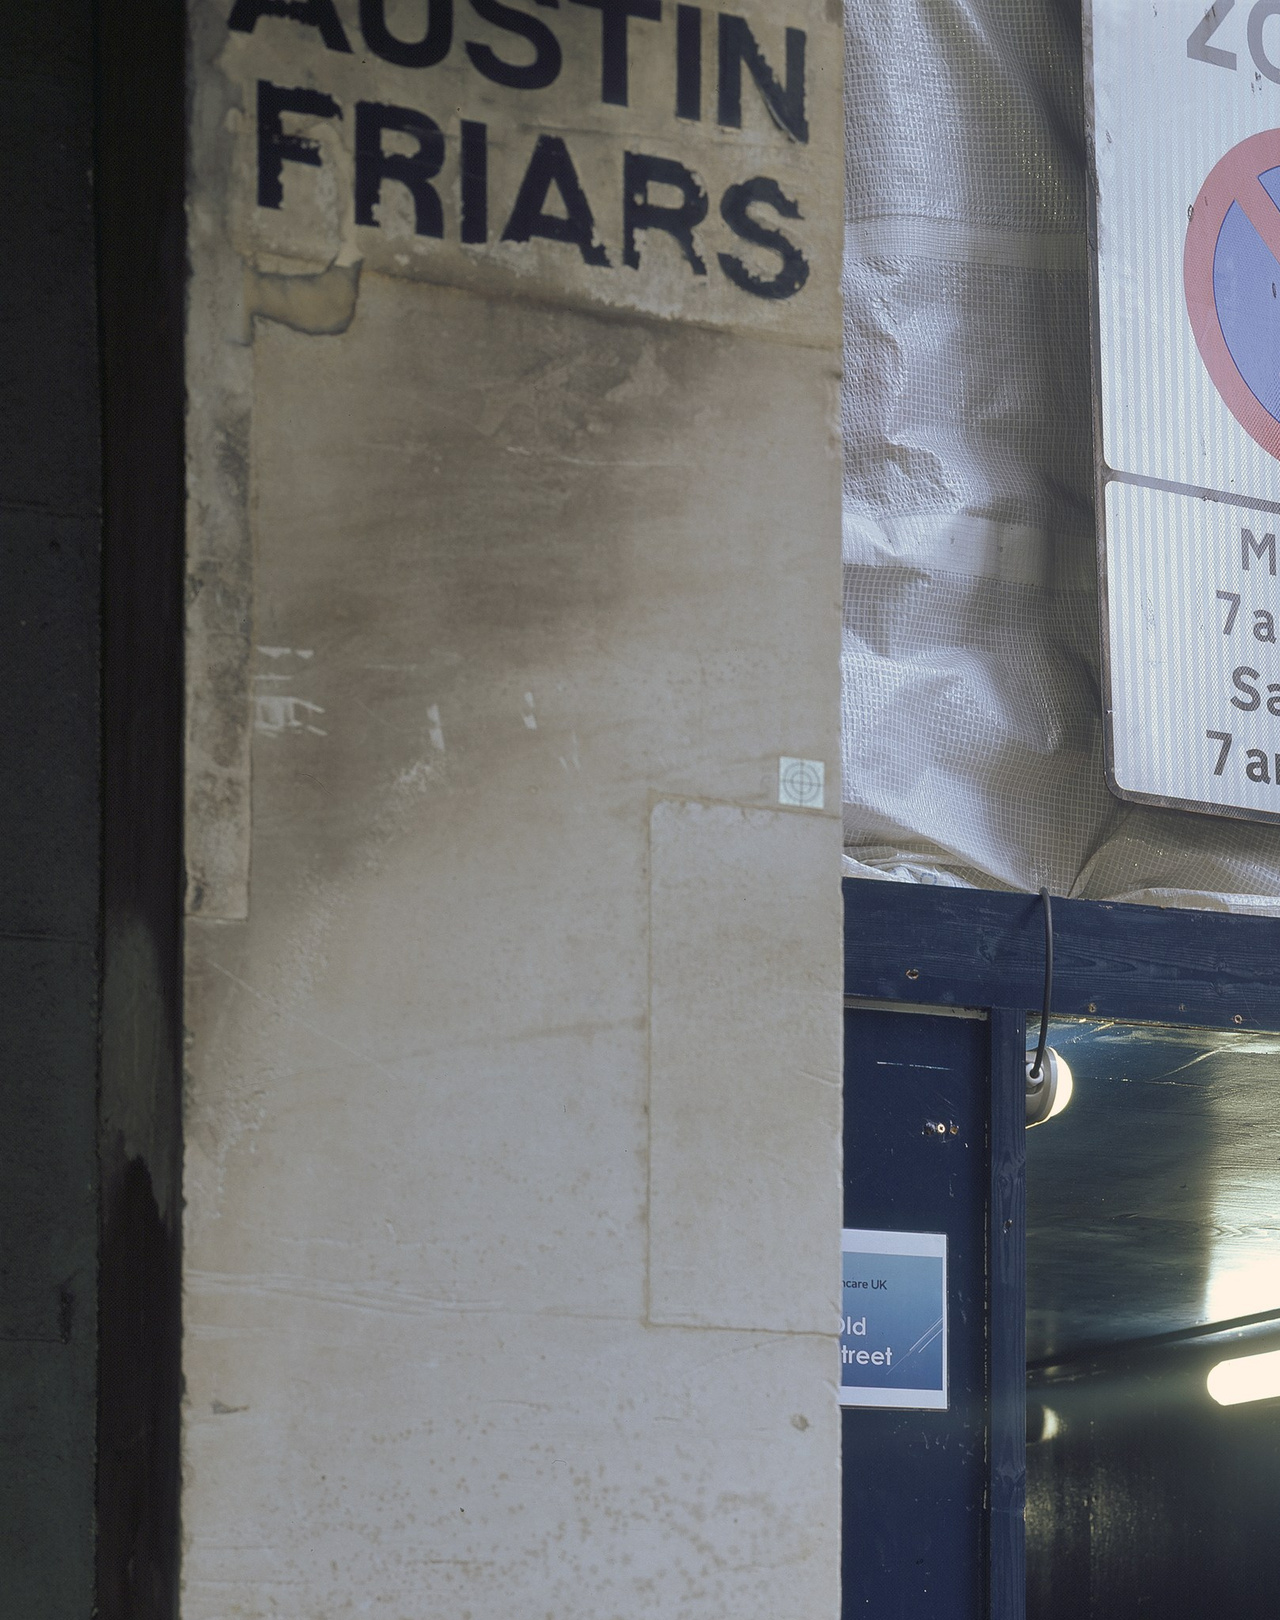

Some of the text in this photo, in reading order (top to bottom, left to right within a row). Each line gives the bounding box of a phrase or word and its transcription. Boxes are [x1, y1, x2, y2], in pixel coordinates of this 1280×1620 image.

[257, 79, 810, 299] FRIARS
[842, 1279, 888, 1290] care UK
[841, 1345, 893, 1366] treet
